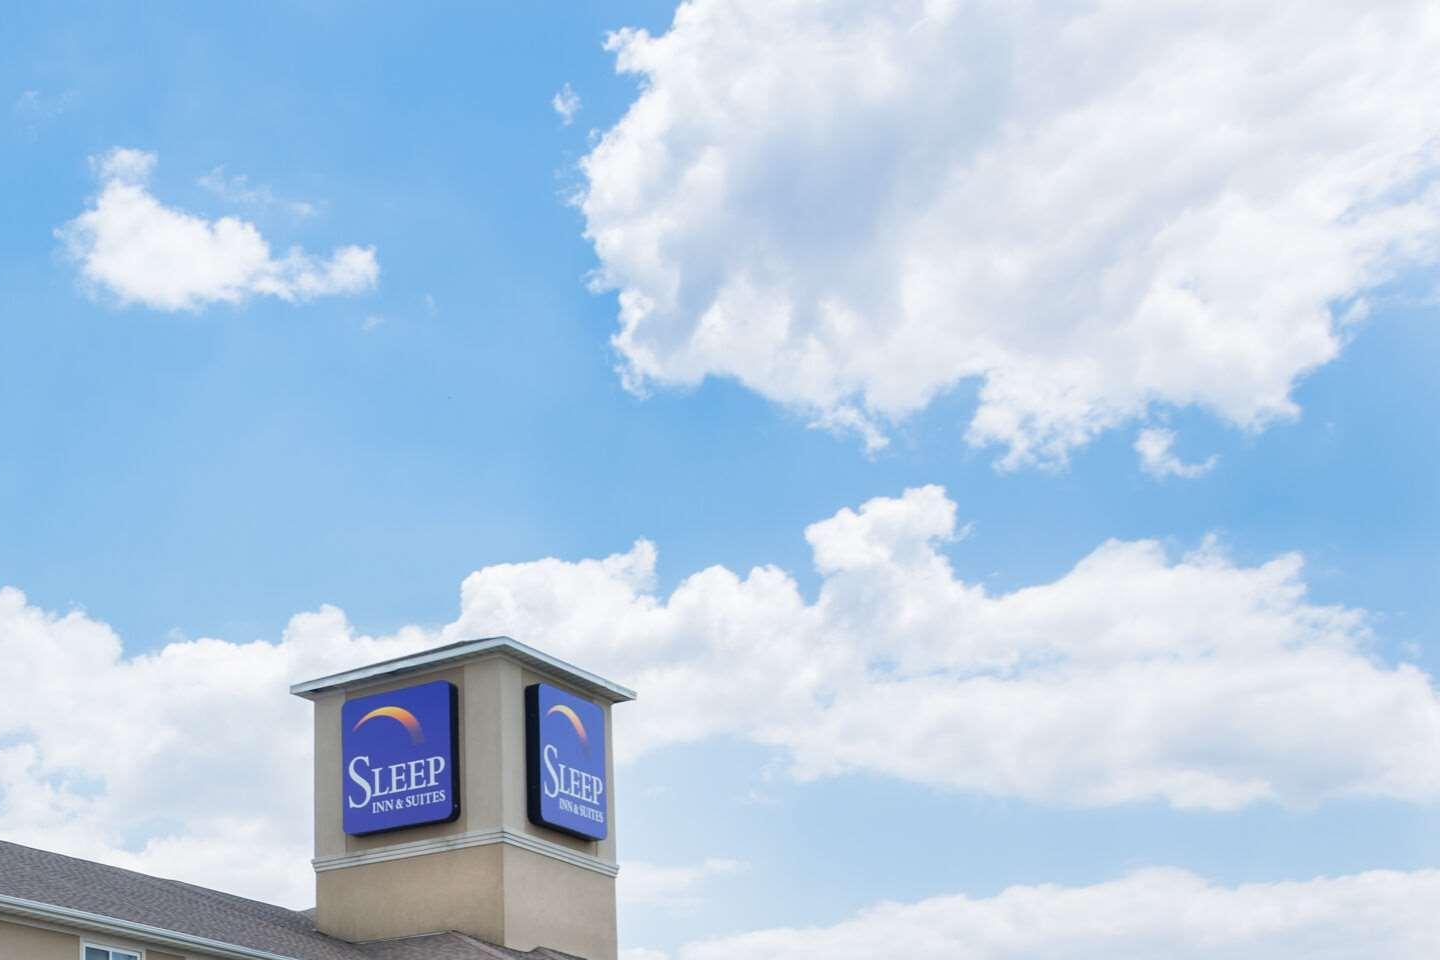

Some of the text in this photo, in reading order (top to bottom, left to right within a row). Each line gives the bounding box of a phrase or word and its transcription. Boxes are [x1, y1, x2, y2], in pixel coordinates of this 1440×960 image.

[348, 756, 446, 809] SLEEP
[543, 744, 604, 806] SLEEP
[371, 789, 447, 814] INN & SUITES
[559, 797, 604, 824] INN & SUITES
